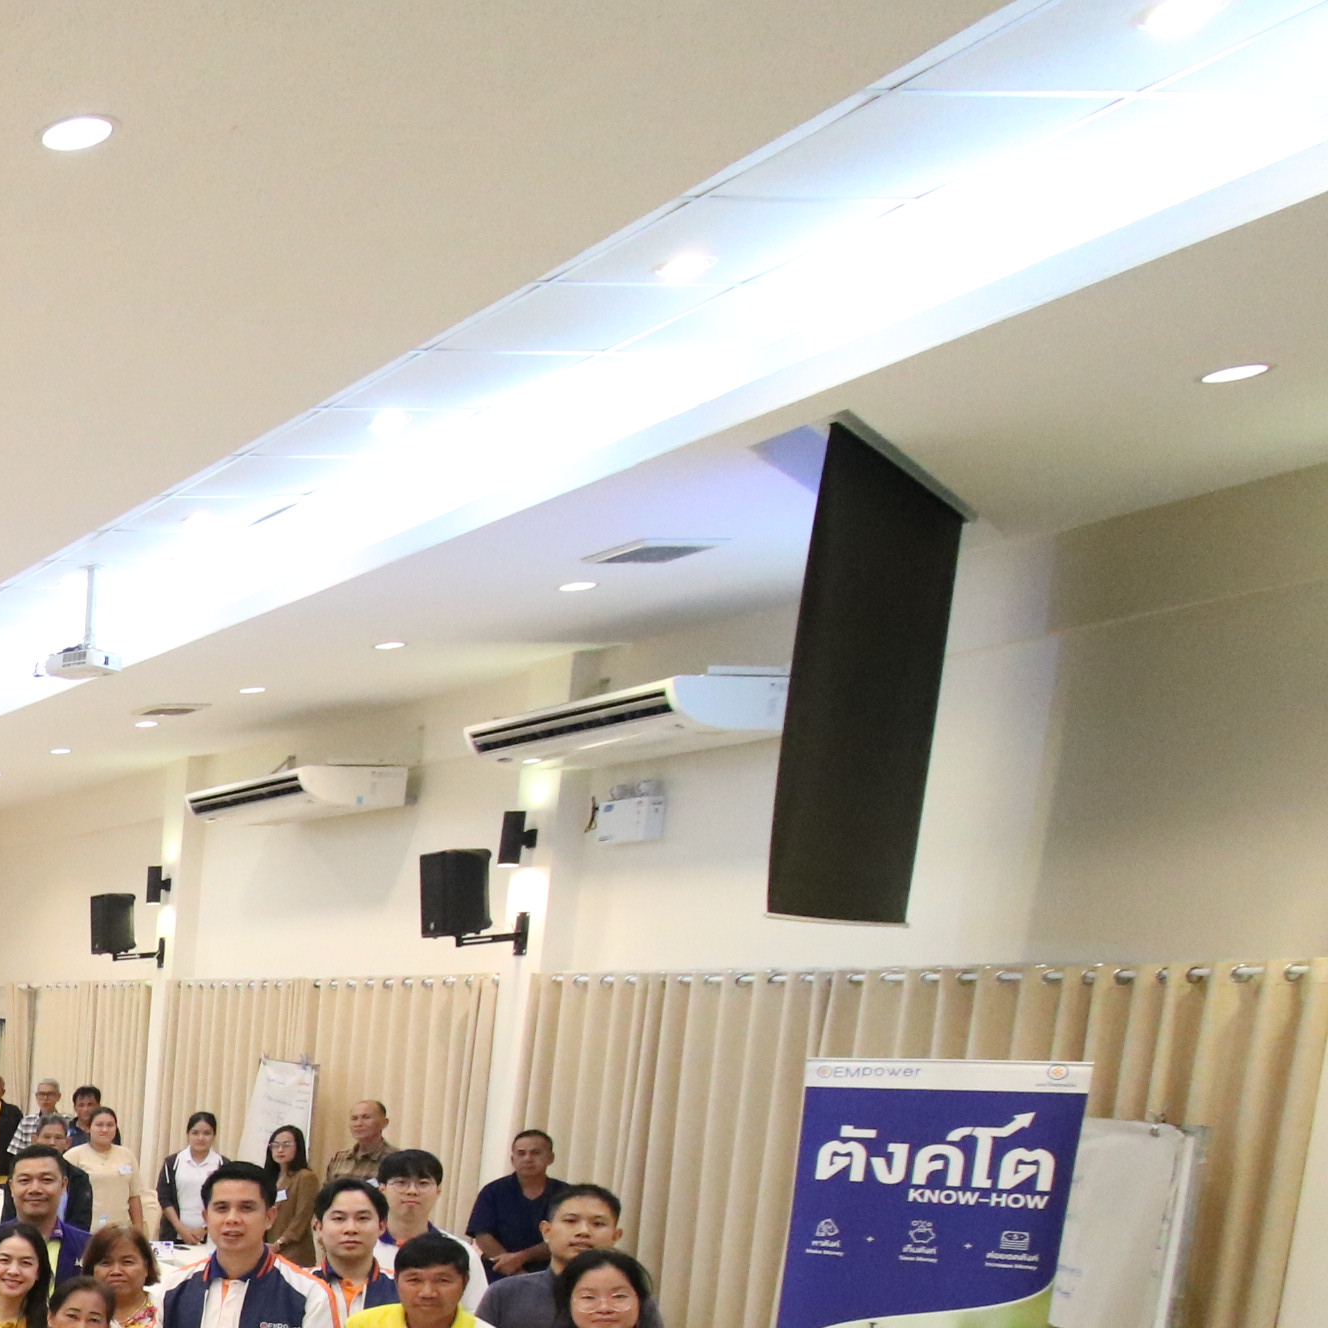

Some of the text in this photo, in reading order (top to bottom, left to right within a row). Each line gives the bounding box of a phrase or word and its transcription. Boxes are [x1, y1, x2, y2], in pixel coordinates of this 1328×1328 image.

[814, 1111, 1057, 1192] ตังค์โต
[907, 1188, 1050, 1210] KNOW-HOW
